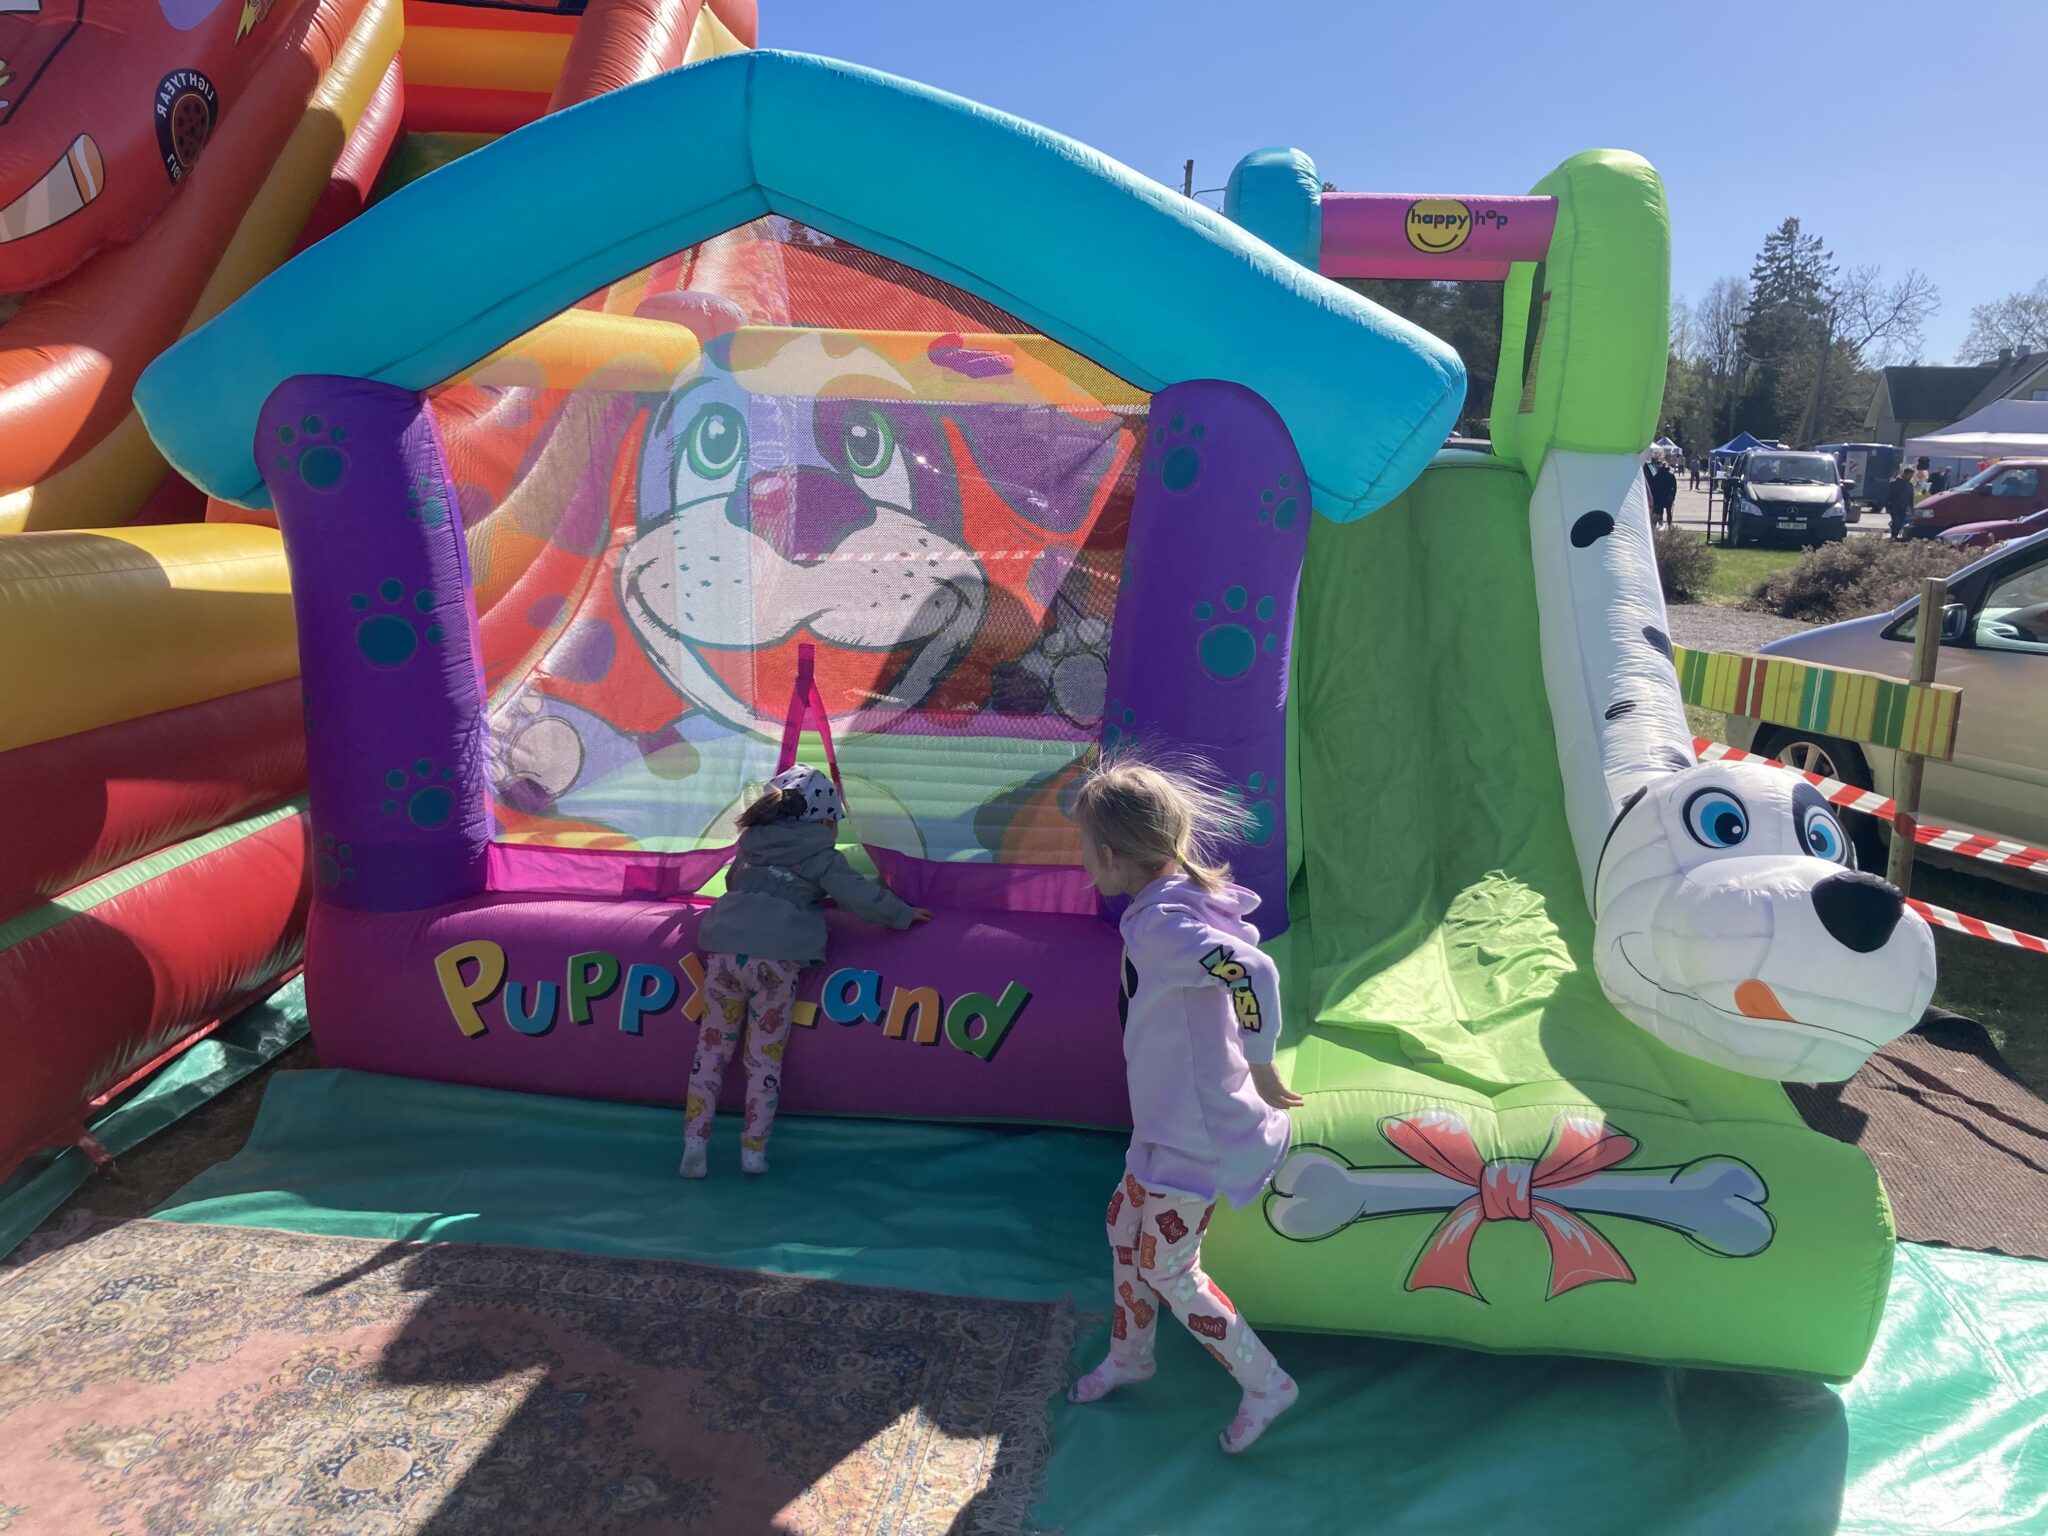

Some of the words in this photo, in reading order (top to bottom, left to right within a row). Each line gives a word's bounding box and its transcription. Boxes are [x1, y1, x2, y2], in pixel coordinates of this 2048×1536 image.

[1411, 209, 1469, 230] happy
[1475, 209, 1508, 230] hop
[792, 968, 1032, 1061] and
